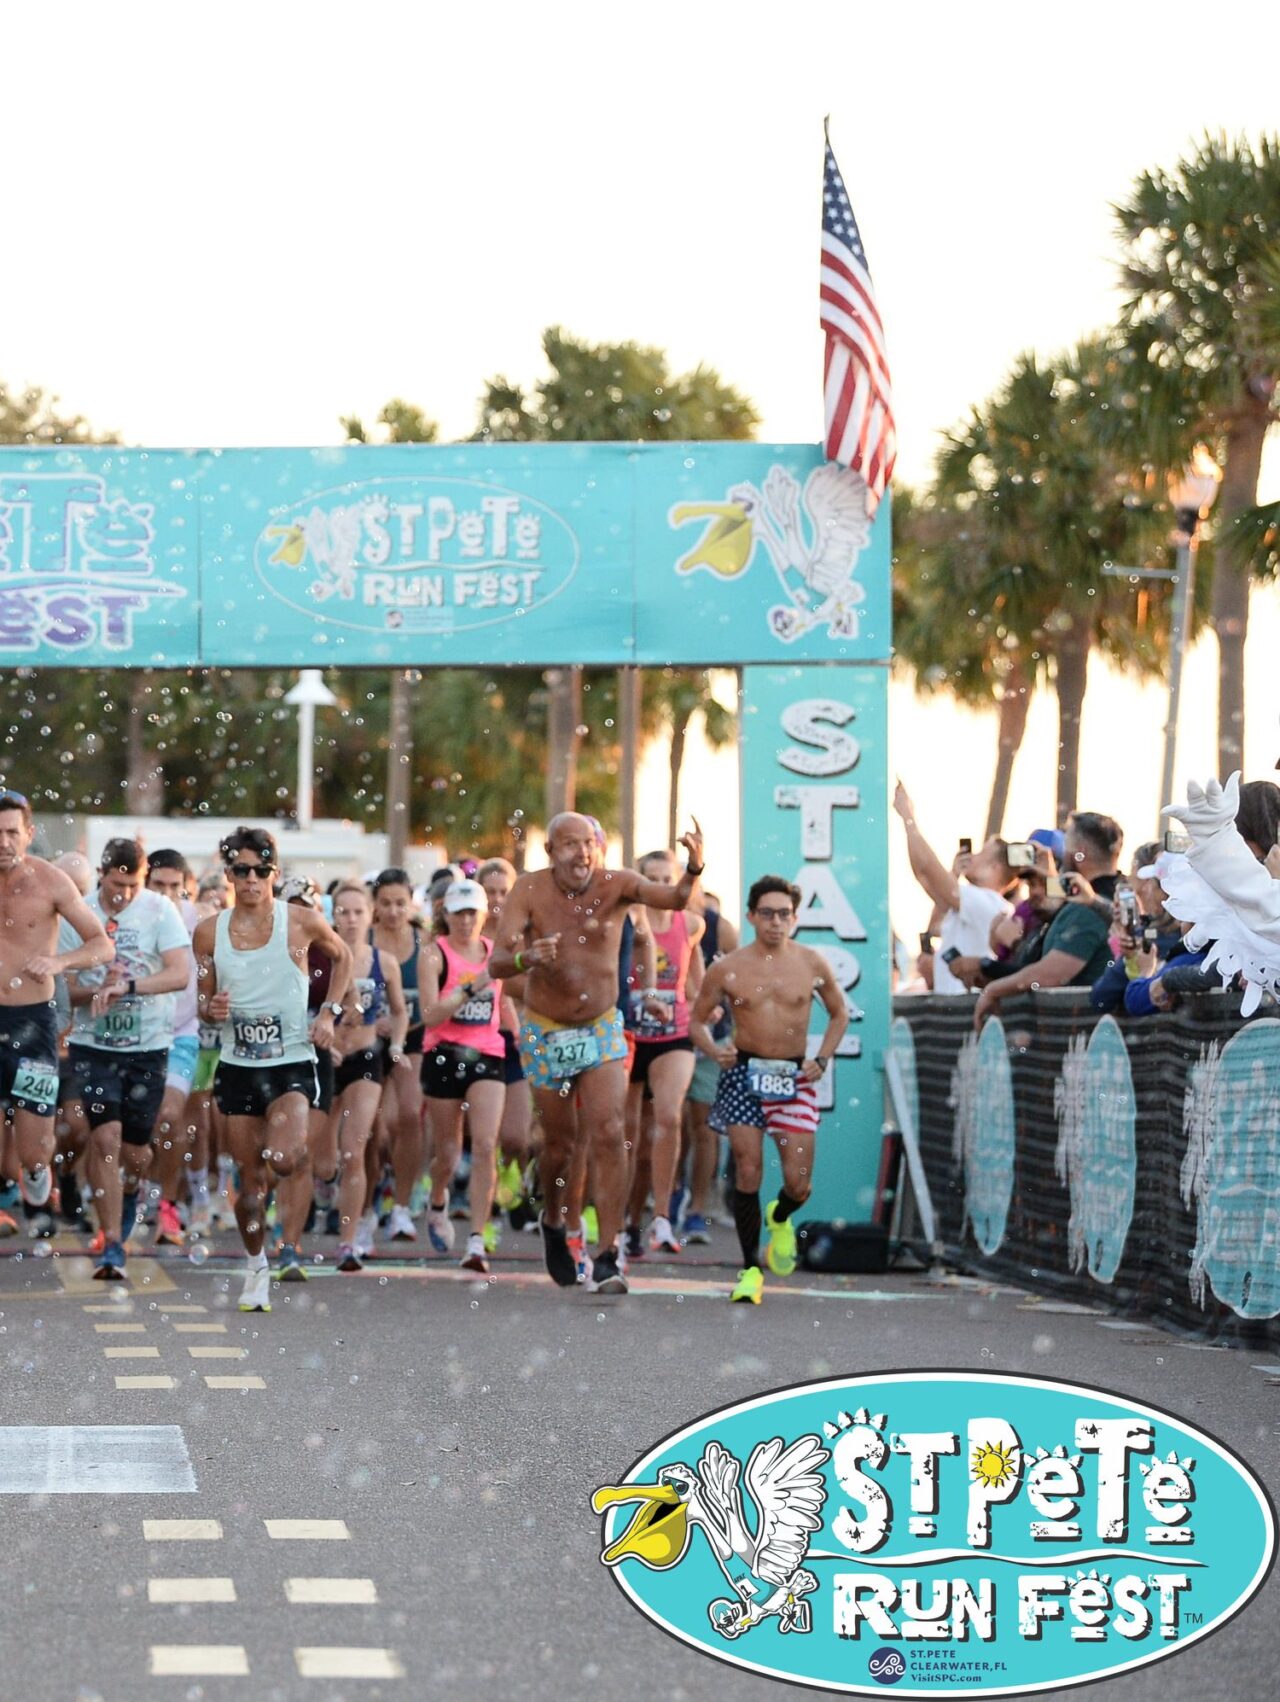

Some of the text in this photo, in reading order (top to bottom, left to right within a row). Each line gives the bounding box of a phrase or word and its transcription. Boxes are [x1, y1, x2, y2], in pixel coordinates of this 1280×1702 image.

[235, 1023, 280, 1043] 1902
[554, 1042, 586, 1063] 237
[22, 1075, 53, 1096] 240
[750, 1073, 795, 1096] 1883
